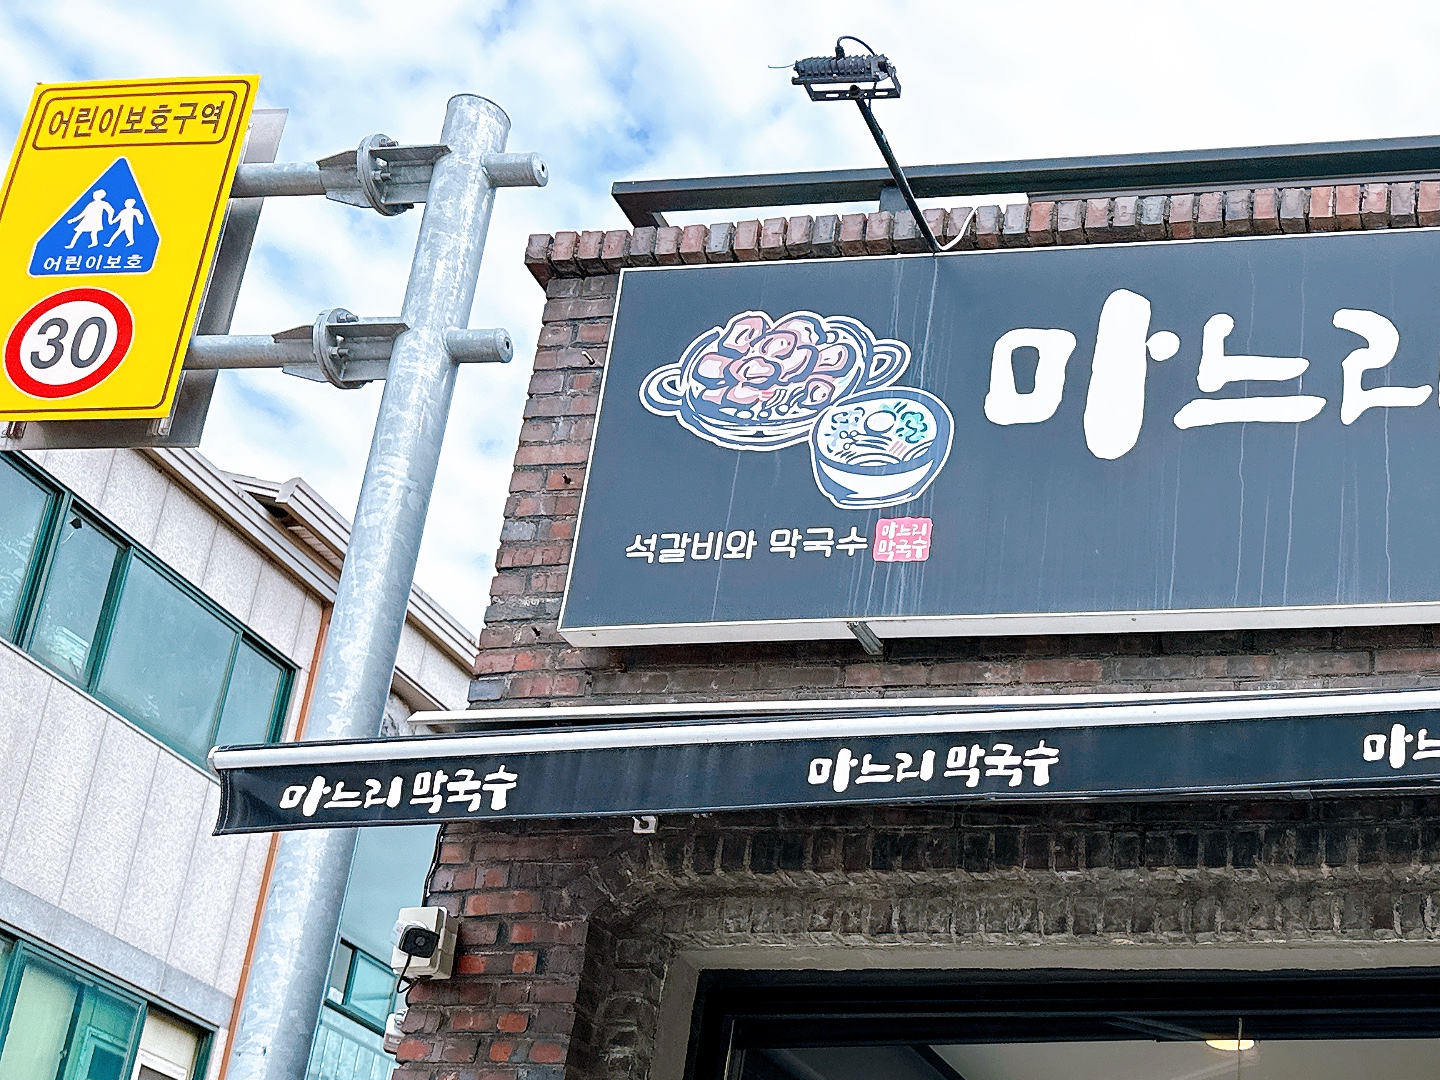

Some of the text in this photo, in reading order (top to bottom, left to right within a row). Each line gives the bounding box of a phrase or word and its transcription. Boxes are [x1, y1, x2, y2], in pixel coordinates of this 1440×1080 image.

[48, 101, 226, 140] 어린이보호구역
[43, 254, 144, 272] 어린이보호
[29, 315, 108, 371] 30
[625, 526, 869, 564] 석갈비와 막국수
[876, 535, 929, 561] 막국수
[881, 520, 929, 539] 마느리
[807, 739, 1060, 793] 마느리 막국수
[279, 764, 519, 818] 마느리 막국수
